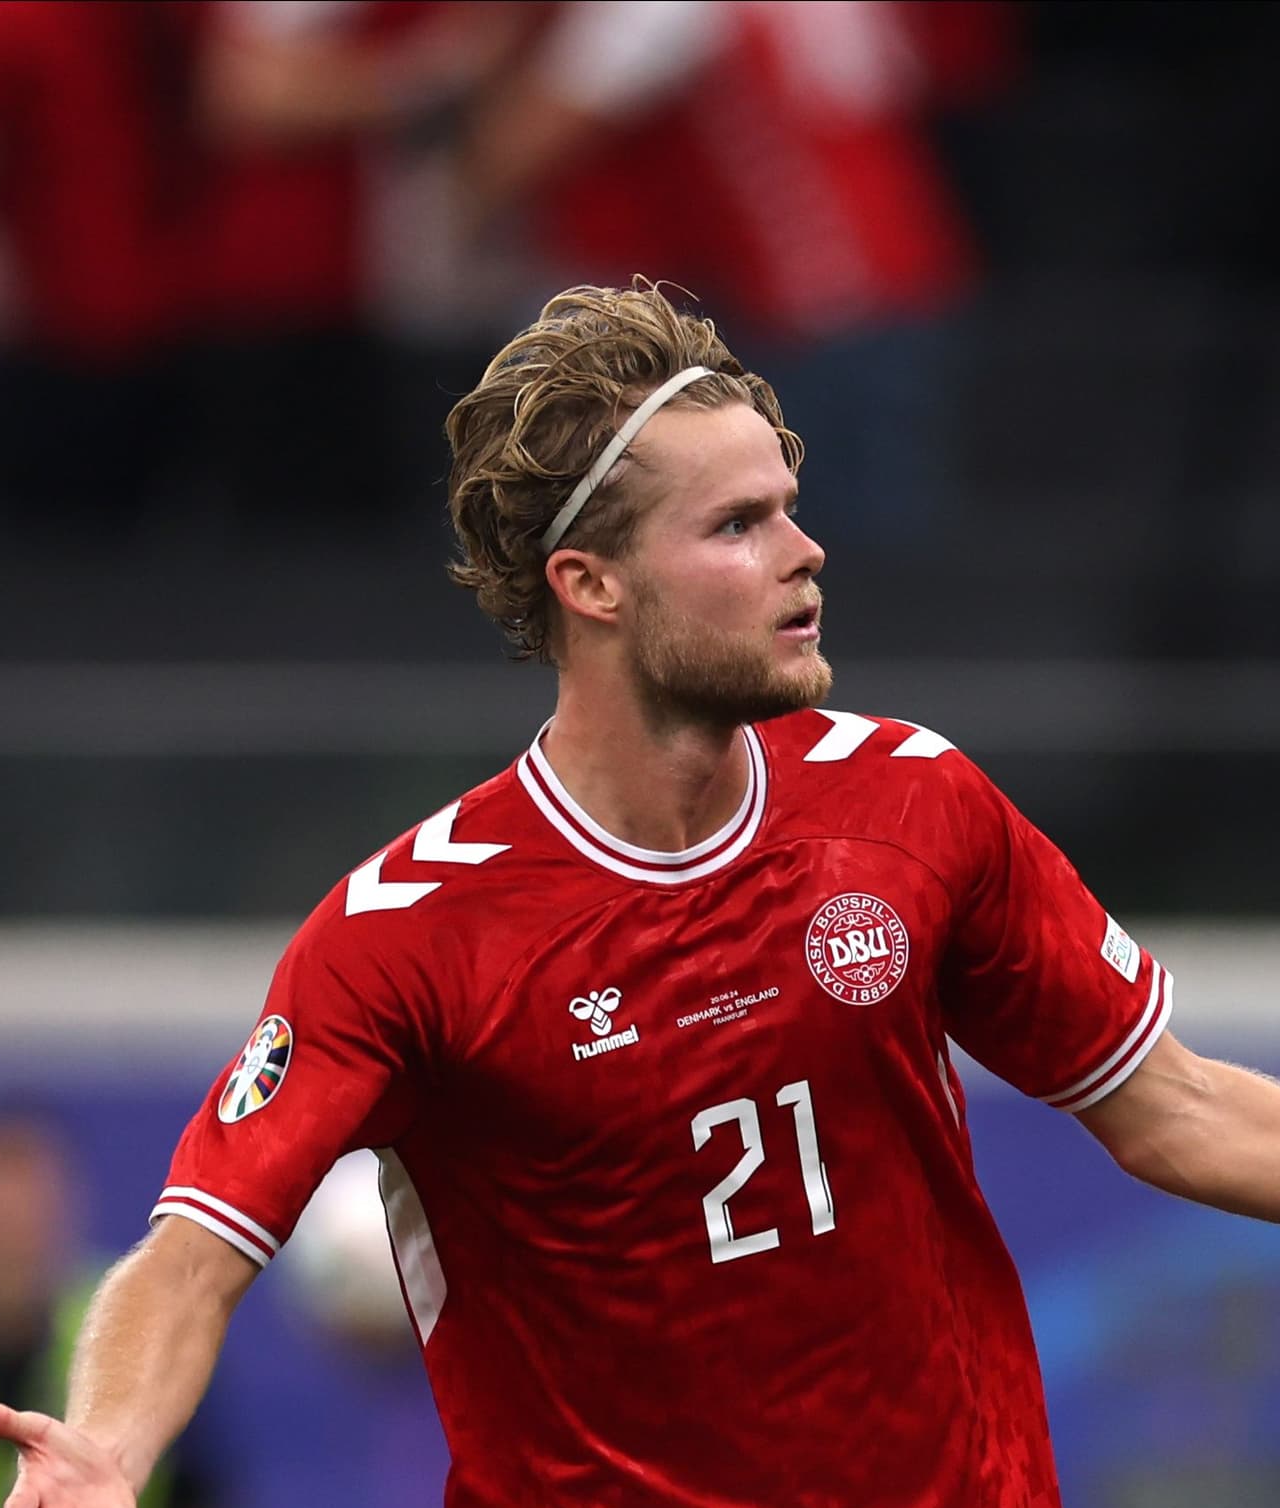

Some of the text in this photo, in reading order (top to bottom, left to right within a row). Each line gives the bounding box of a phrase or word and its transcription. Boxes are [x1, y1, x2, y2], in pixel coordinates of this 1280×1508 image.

[826, 926, 891, 969] DBU
[676, 1005, 722, 1028] DENMARK
[734, 986, 780, 1009] ENGLAND
[851, 981, 889, 1002] 1889
[712, 1008, 749, 1026] FRANKFURT
[572, 1023, 640, 1061] hummel
[691, 1080, 836, 1264] 21
